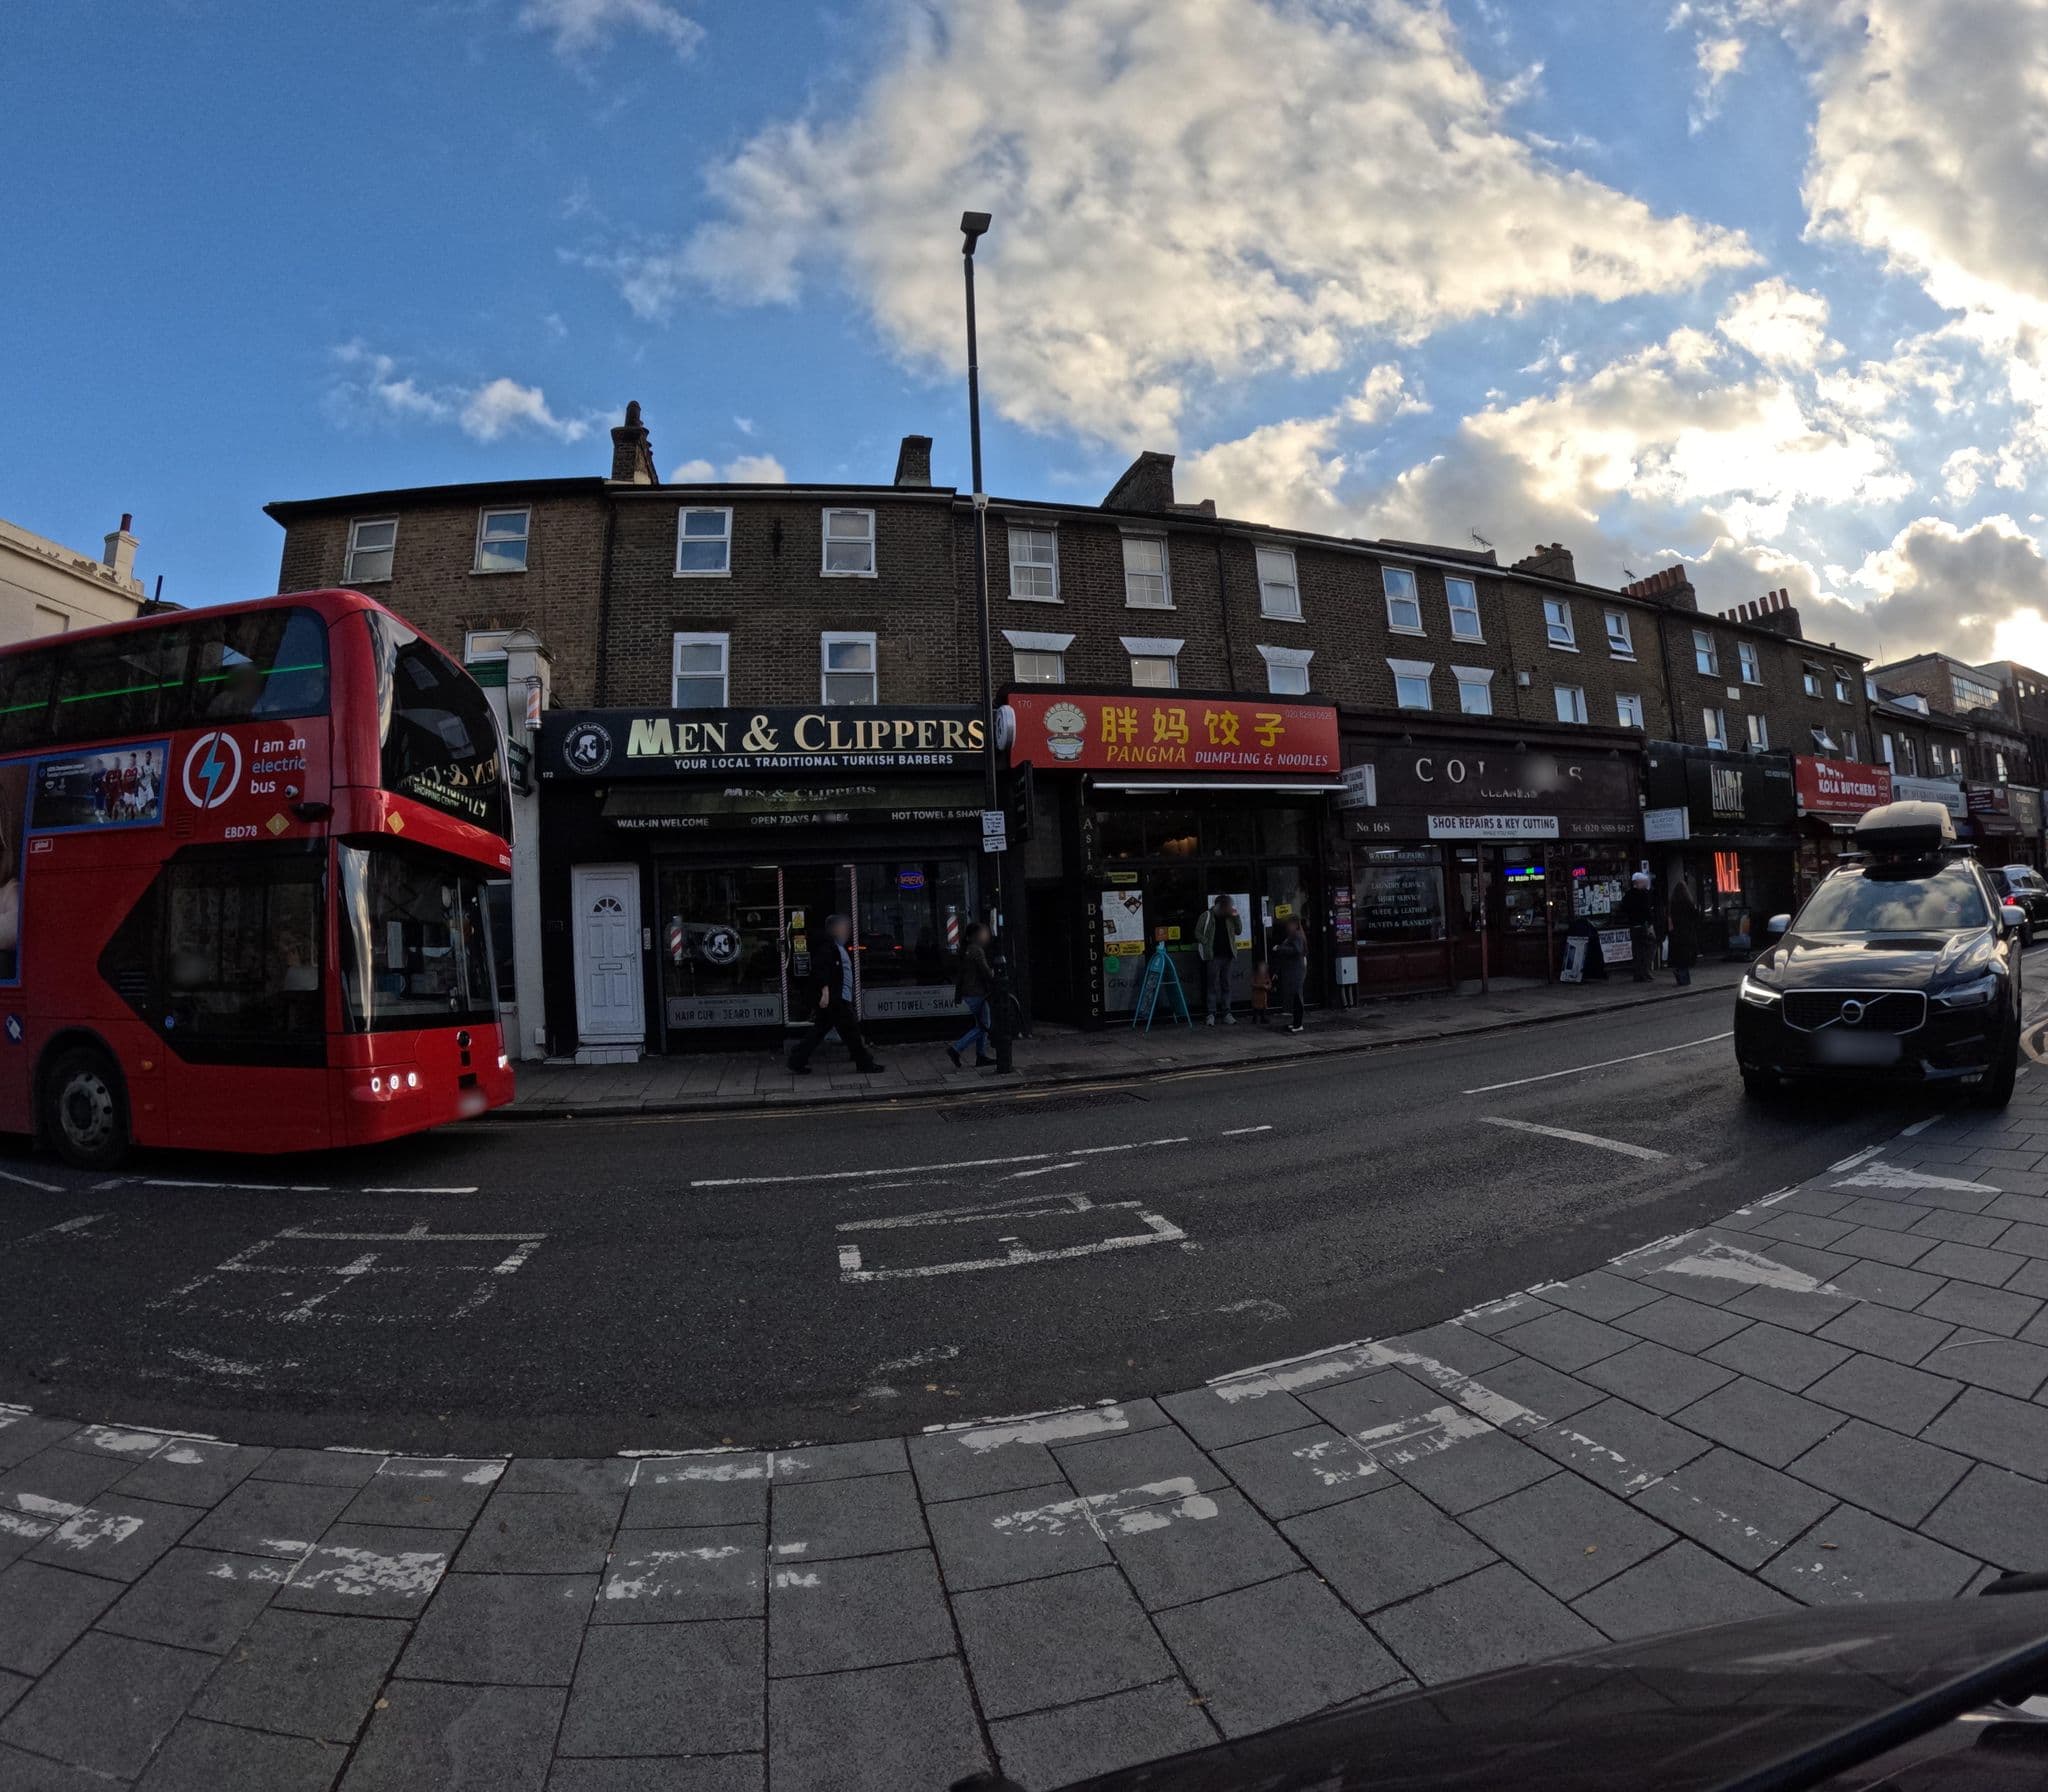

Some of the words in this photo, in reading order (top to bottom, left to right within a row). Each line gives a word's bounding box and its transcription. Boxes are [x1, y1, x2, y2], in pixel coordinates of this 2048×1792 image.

[1101, 706, 1285, 747] 胖妈饺子
[627, 718, 728, 756] MEN
[742, 714, 779, 752] &
[793, 714, 984, 751] CLIPPERS
[254, 739, 259, 753] I
[262, 740, 283, 753] am
[288, 738, 305, 751] an
[1107, 745, 1186, 763] PANGMA
[1195, 751, 1260, 765] DUMPLING
[1263, 753, 1273, 766] &
[1278, 754, 1328, 767] NOODLES
[252, 758, 306, 774] electric
[674, 758, 707, 770] YOUR
[711, 757, 751, 769] LOCAL
[755, 756, 838, 767] TRADITIONAL
[842, 755, 894, 766] TURKISH
[898, 754, 953, 765] BARBERS
[250, 779, 276, 794] bus
[1818, 779, 1840, 794] KOLA
[1841, 781, 1876, 797] BUTCHERS
[750, 816, 777, 825] OPEN
[891, 811, 911, 820] HOT
[913, 810, 945, 820] TOWEL
[947, 811, 954, 819] &
[616, 819, 659, 829] WALK-IN
[660, 817, 709, 828] WELCOME
[1373, 822, 1390, 832] 168
[1432, 817, 1456, 828] SHOE
[1459, 818, 1494, 829] REPAIRS
[1496, 818, 1503, 829] &
[1505, 818, 1520, 829] KEY
[1523, 818, 1555, 829] CUTTING
[224, 825, 257, 838] EBD78
[753, 1007, 774, 1018] TRIM
[878, 1000, 893, 1012] HOT
